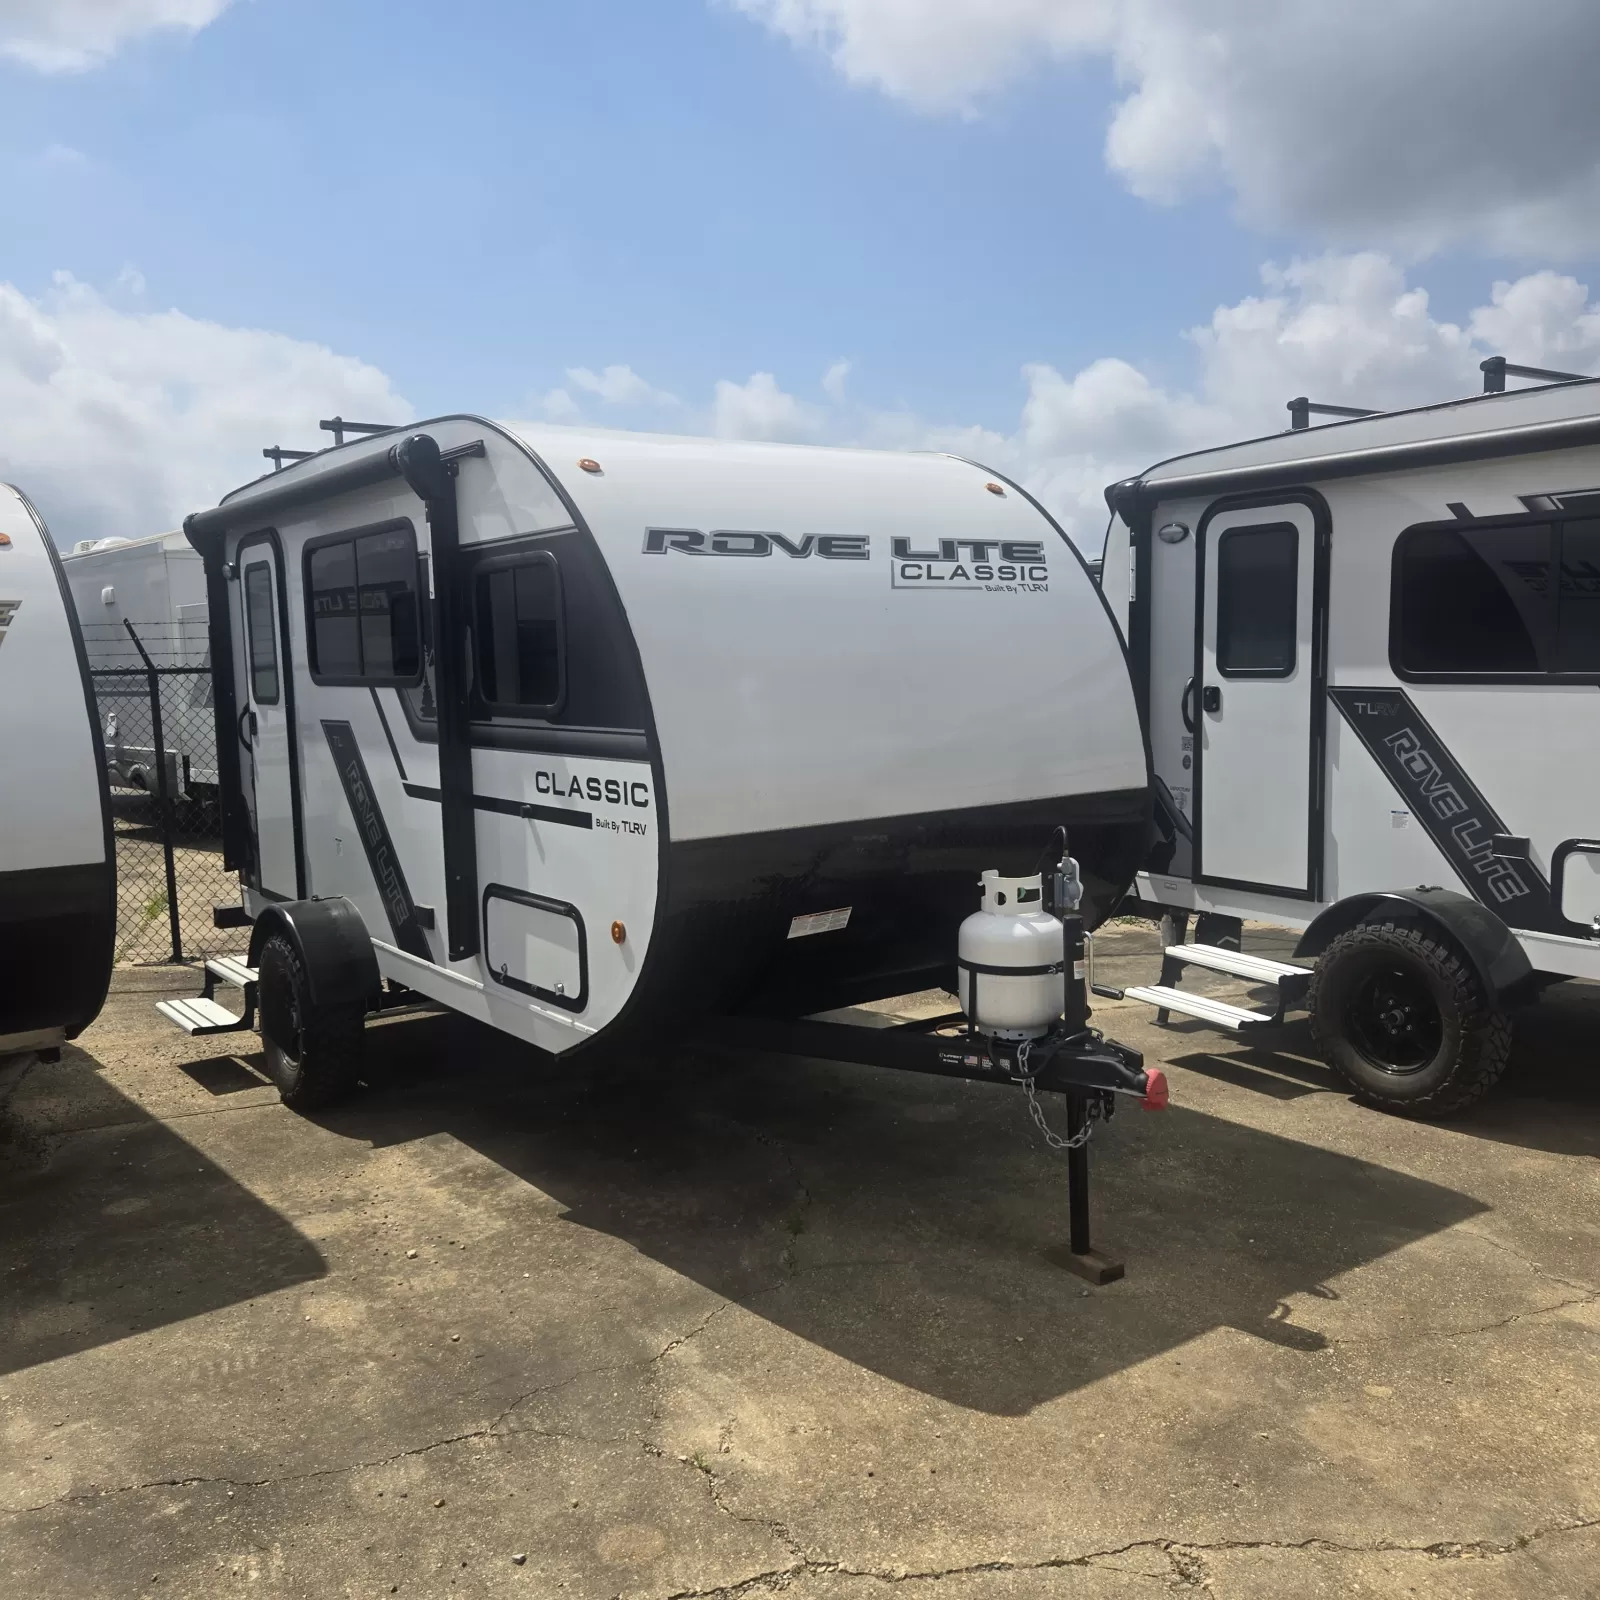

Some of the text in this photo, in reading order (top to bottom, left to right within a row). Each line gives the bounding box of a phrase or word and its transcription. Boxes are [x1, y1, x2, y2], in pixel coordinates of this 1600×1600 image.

[642, 526, 1046, 564] ROVE LITE
[900, 564, 1049, 582] CLASSIC
[985, 583, 1049, 594] Built By TLRV
[1354, 702, 1400, 717] TLRV
[535, 771, 648, 808] CLASSIC
[596, 818, 647, 836] Built By TLRV
[1383, 727, 1531, 903] ROVE LITE
[346, 759, 410, 926] ROVE LITE
